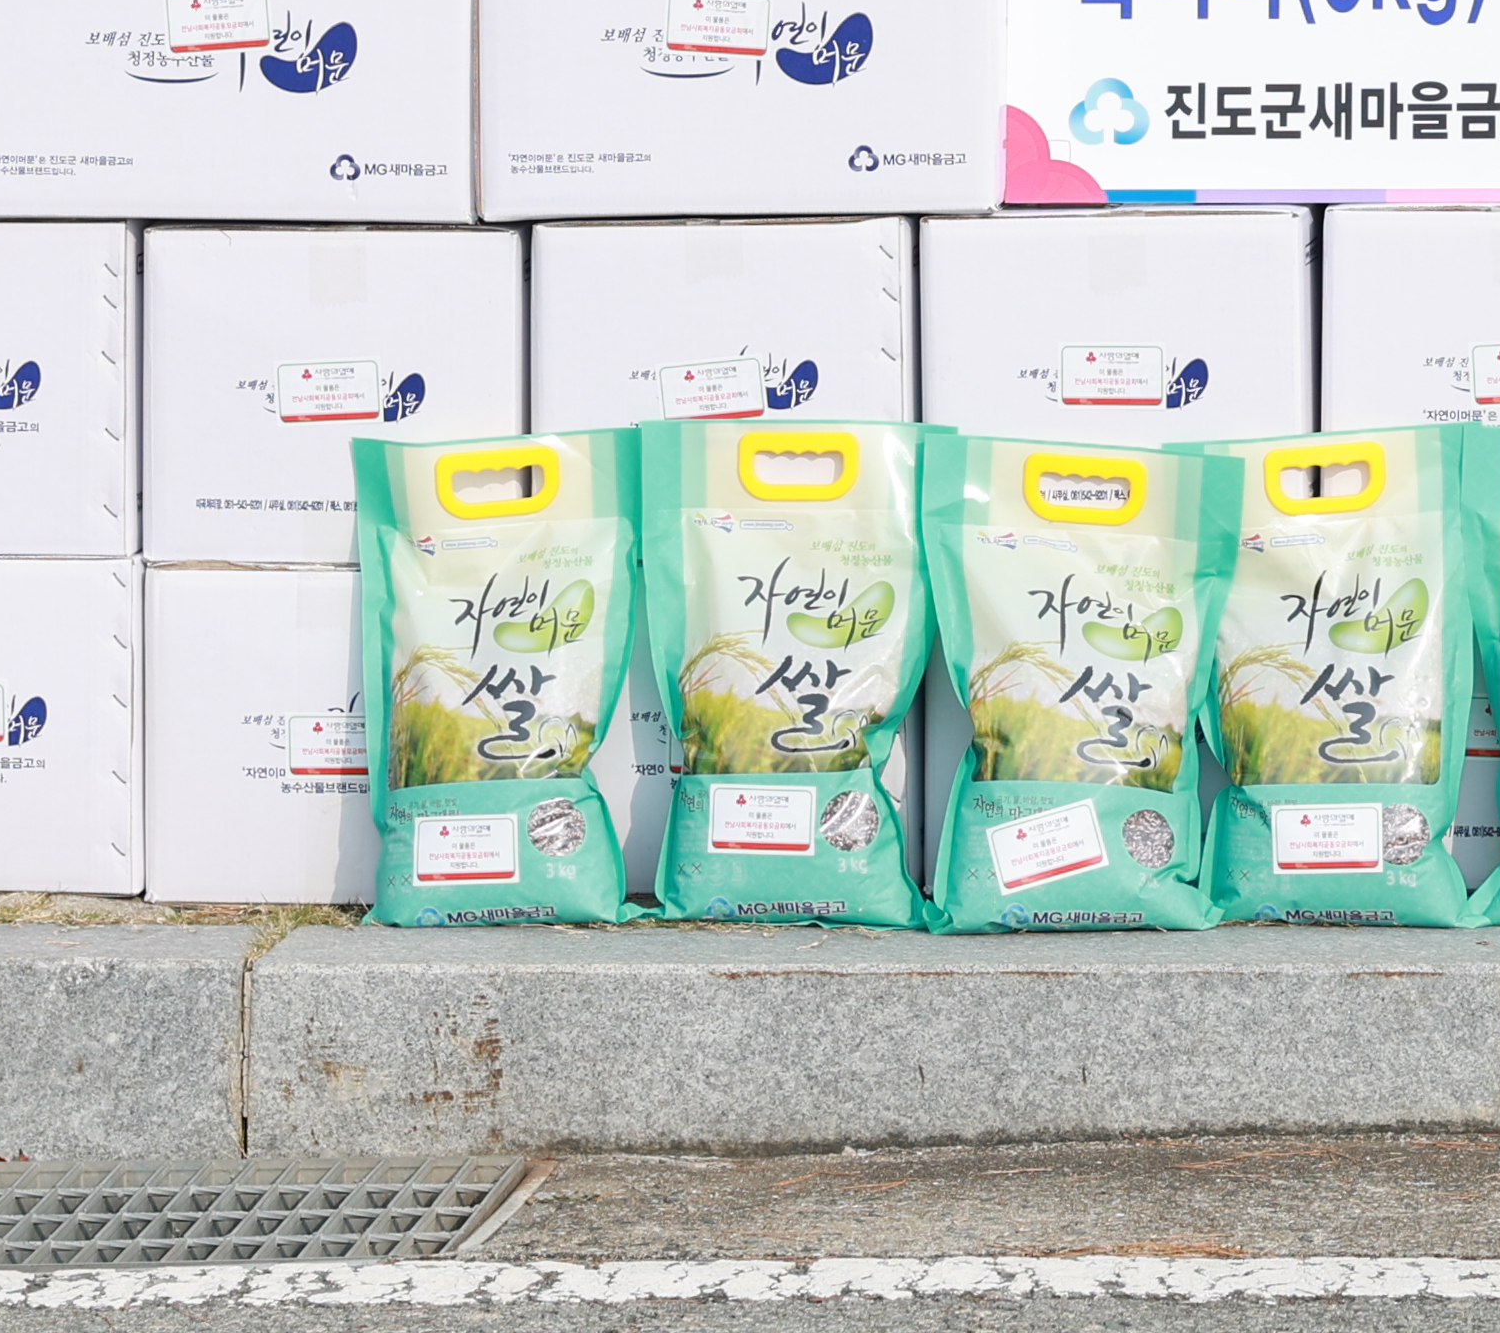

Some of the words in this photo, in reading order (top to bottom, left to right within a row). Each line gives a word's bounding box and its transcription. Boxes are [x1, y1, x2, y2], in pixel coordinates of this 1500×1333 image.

[86, 32, 131, 46] 보배섬
[139, 32, 164, 46] 진도
[813, 40, 866, 87] 머문
[49, 155, 76, 166] 진도군
[79, 155, 134, 167] 새마을금고의
[511, 165, 591, 173] 농수산물브랜드입니다.
[567, 152, 595, 163] 진도군
[598, 152, 651, 163] 새마을금고의
[449, 572, 549, 659] 자연이
[528, 607, 584, 659] 머문
[737, 557, 848, 648] 자연이
[826, 606, 884, 652] 머문
[1281, 571, 1381, 656] 자연이
[1364, 606, 1418, 660] 머문
[463, 664, 557, 761] 쌀
[756, 656, 852, 754] 쌀
[1059, 665, 1152, 769] 쌀
[1302, 664, 1395, 764] 쌀
